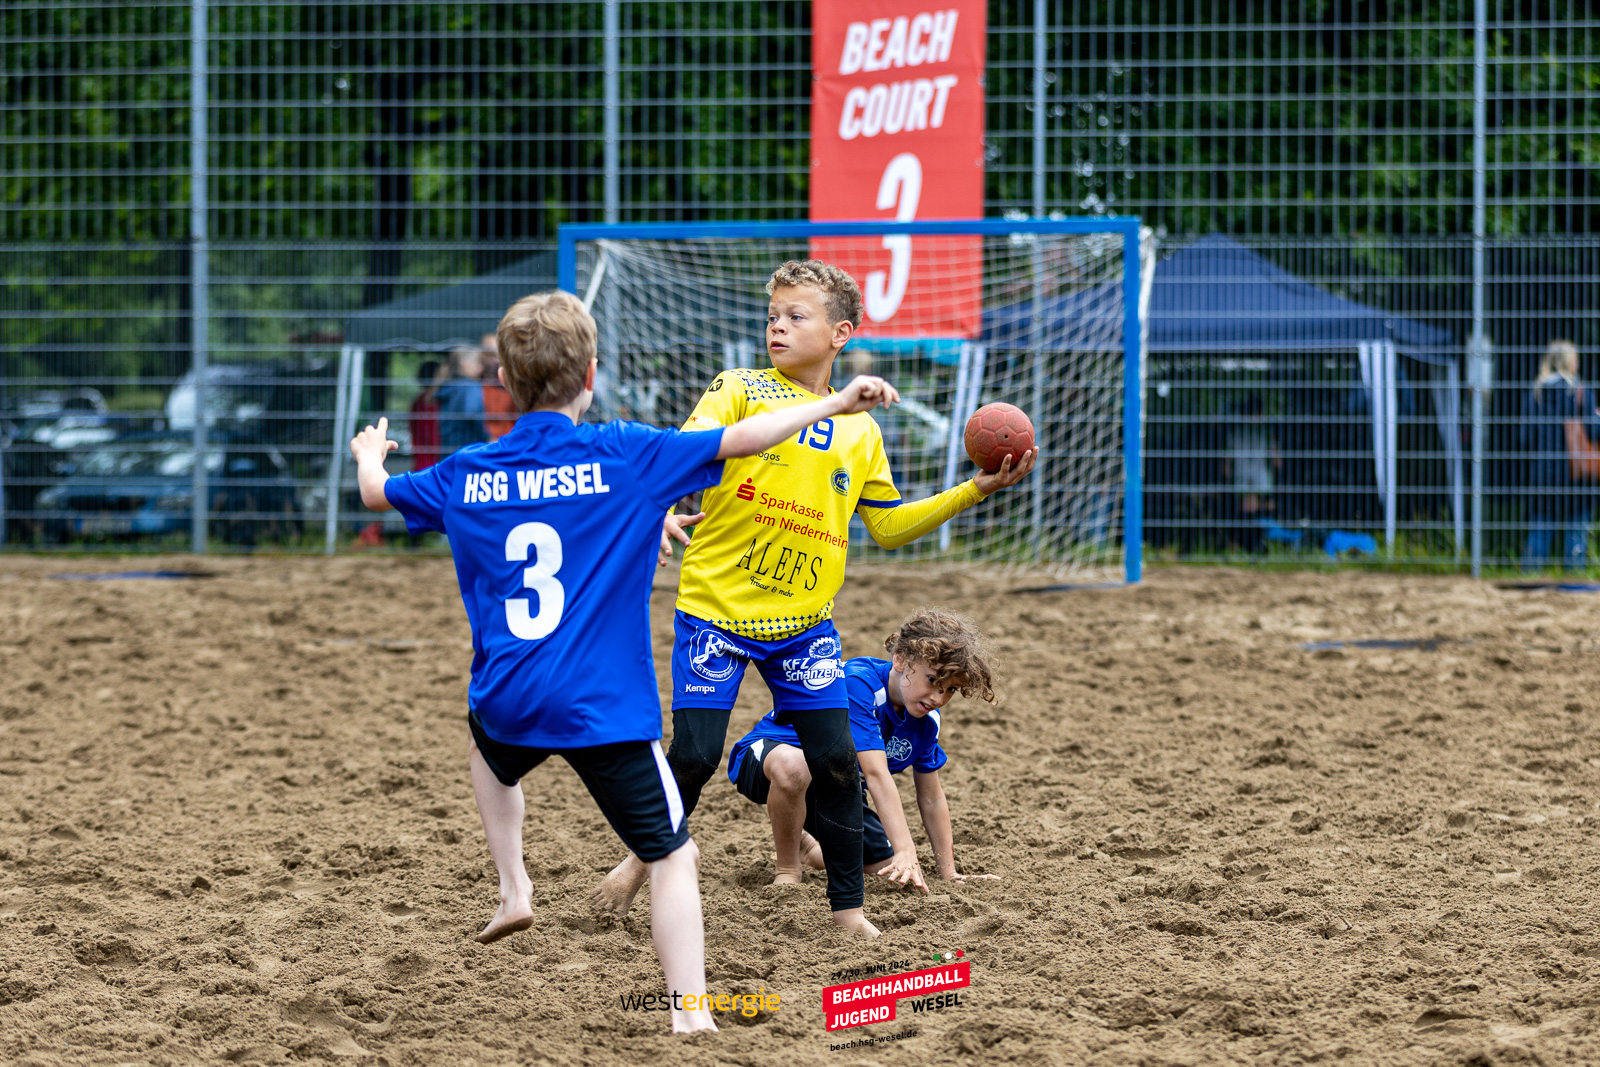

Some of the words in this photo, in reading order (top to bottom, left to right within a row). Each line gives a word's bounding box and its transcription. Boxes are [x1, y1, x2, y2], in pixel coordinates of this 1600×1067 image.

[838, 9, 959, 76] BEACH
[838, 74, 958, 141] COURT
[864, 152, 923, 323] 3
[797, 417, 834, 451] 19
[463, 470, 509, 504] HSG
[516, 462, 611, 501] WESEL
[759, 492, 824, 521] Sparkasse
[754, 513, 776, 527] am
[779, 517, 848, 550] Niederrhein
[505, 521, 565, 641] 3
[736, 538, 823, 591] ALEFS
[783, 657, 811, 671] KFZ
[685, 683, 716, 694] Kempa
